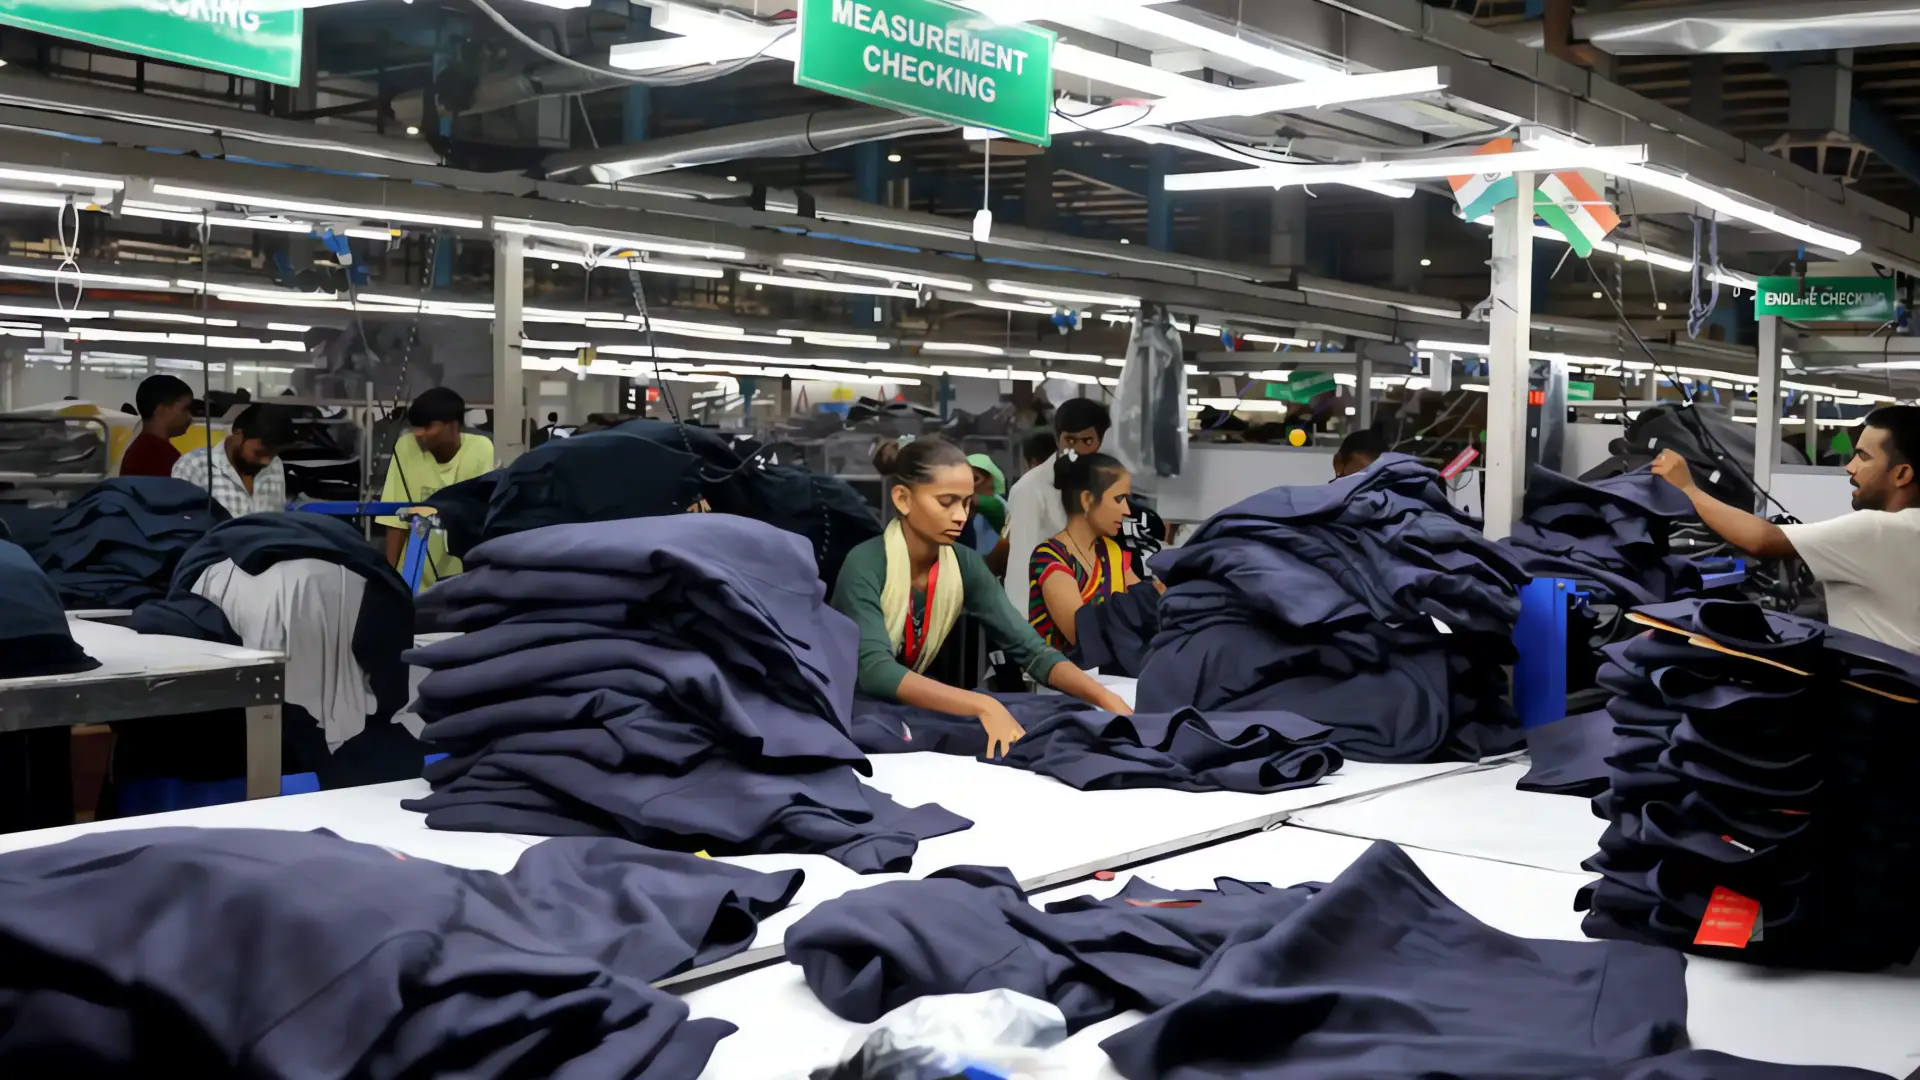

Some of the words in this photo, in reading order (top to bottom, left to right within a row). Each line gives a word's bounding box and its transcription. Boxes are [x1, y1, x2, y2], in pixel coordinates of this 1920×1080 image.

[152, 0, 259, 32] CKING
[832, 0, 1028, 76] MEASUREMENT
[863, 45, 997, 103] CHECKING
[1820, 291, 1886, 306] CHECKING
